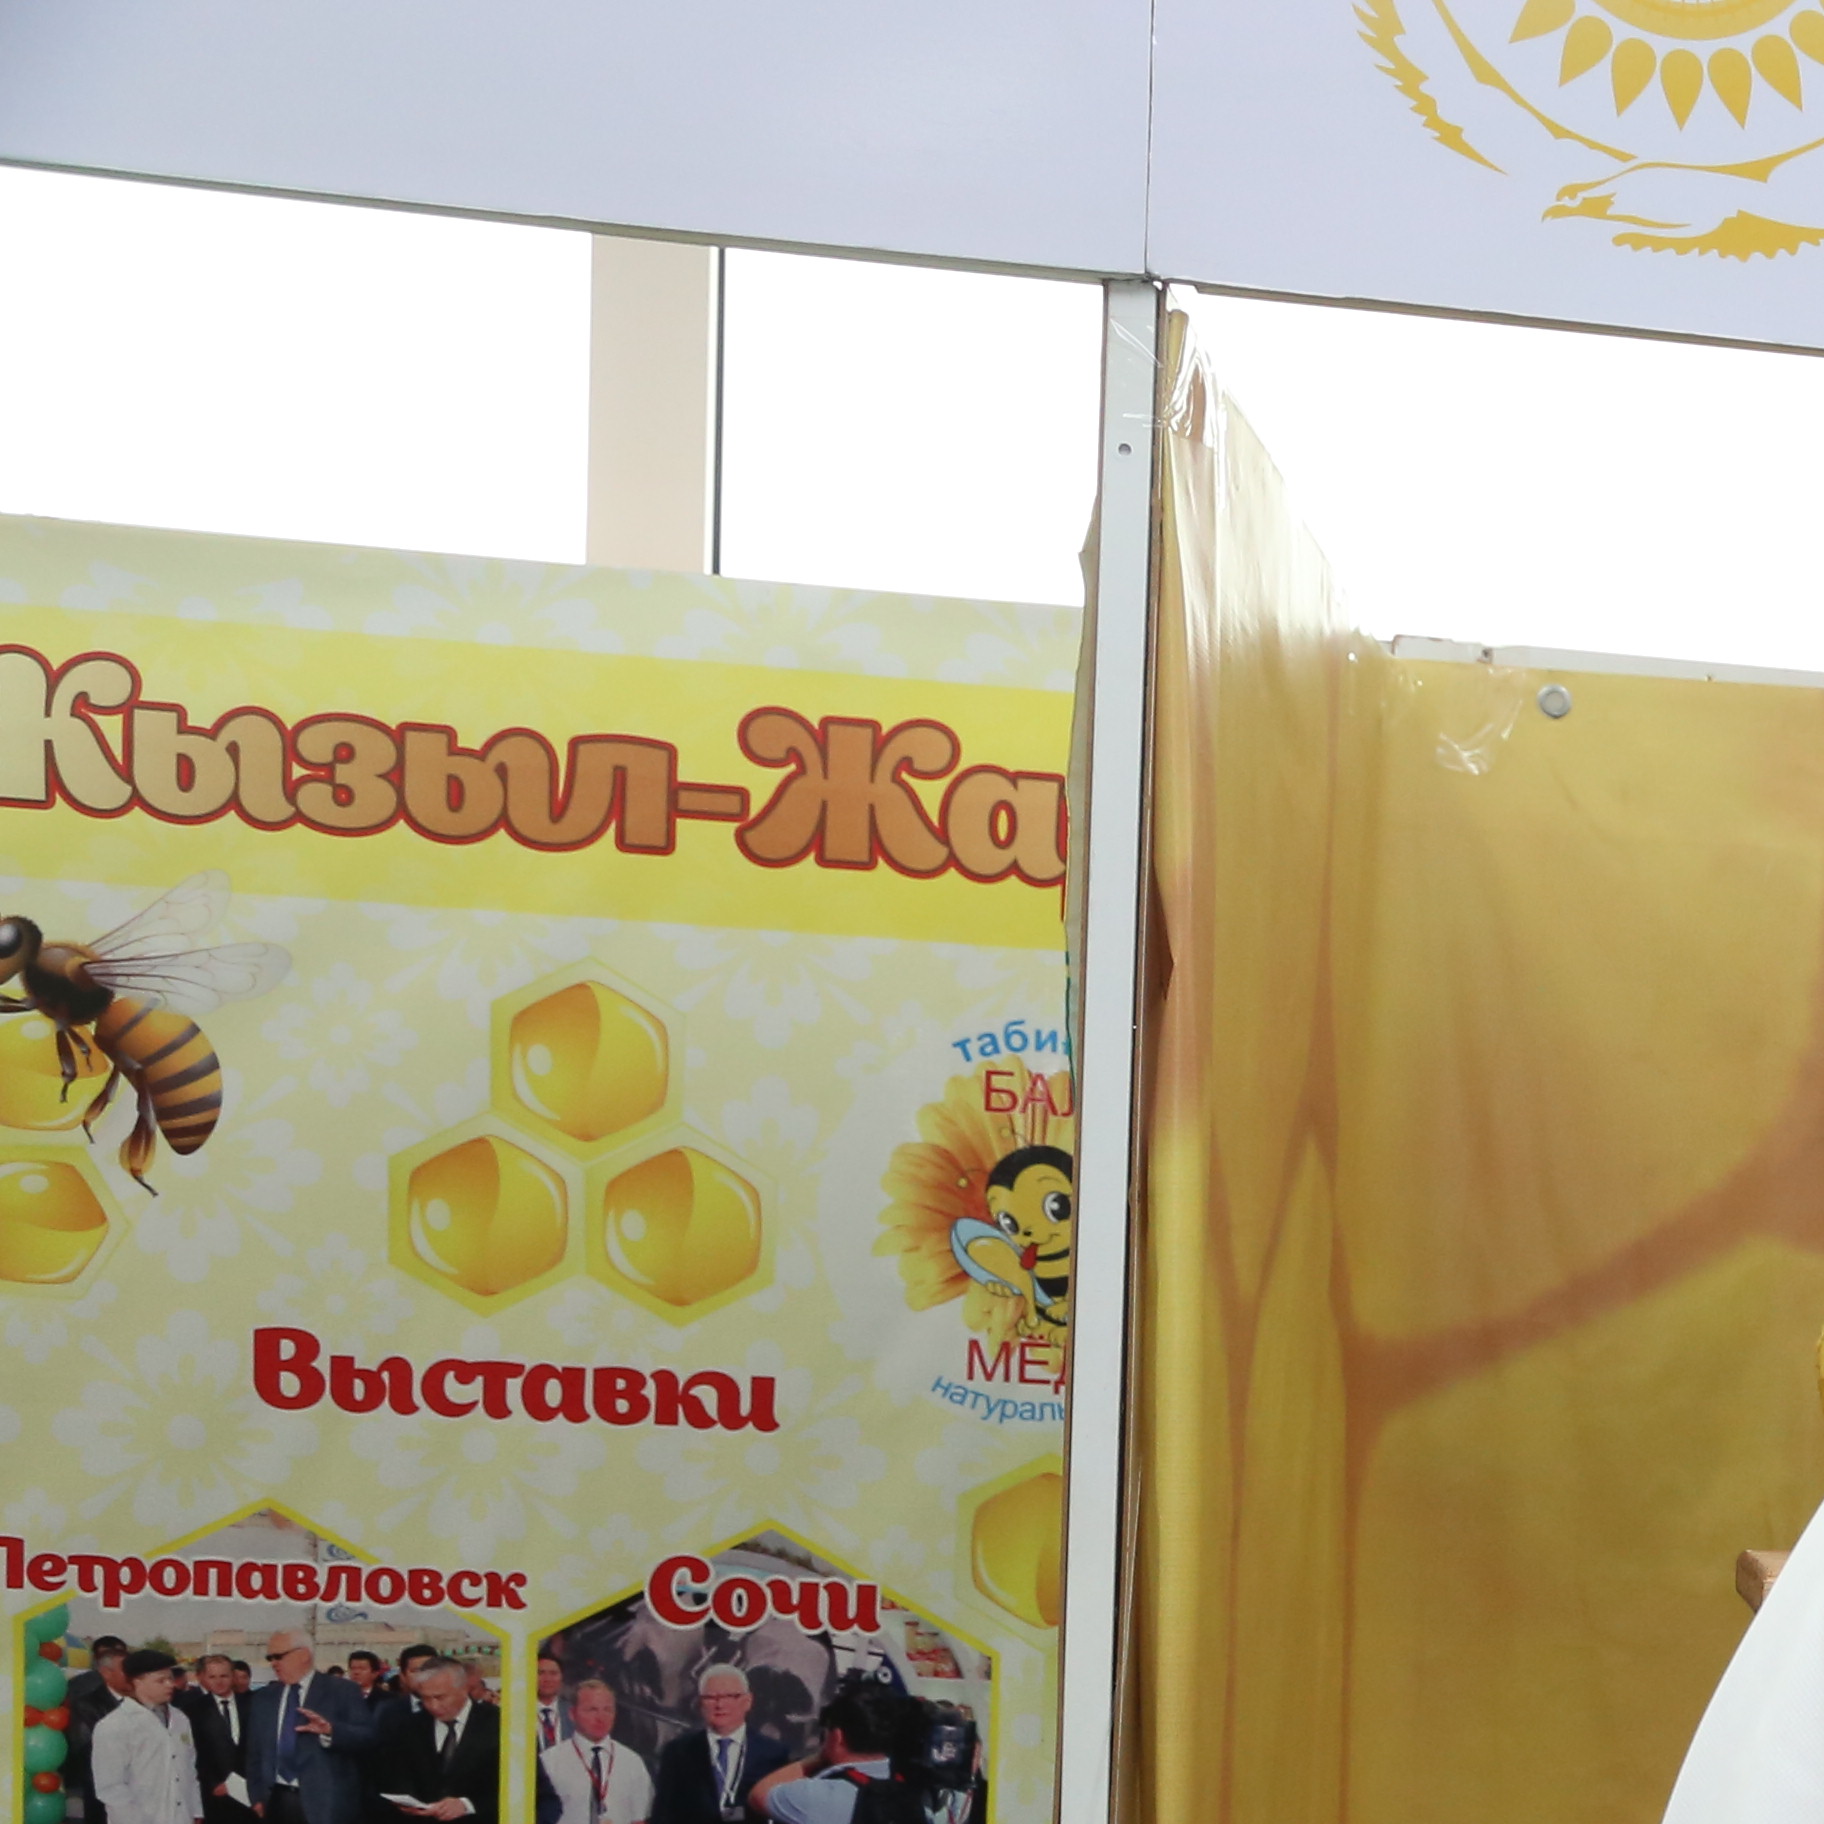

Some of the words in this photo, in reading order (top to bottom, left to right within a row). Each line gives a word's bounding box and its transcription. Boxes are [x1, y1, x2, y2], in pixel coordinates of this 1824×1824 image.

[0, 644, 1067, 895] Кызыл-Жа
[252, 1326, 781, 1432] Выставки
[647, 1554, 883, 1634] Сочи
